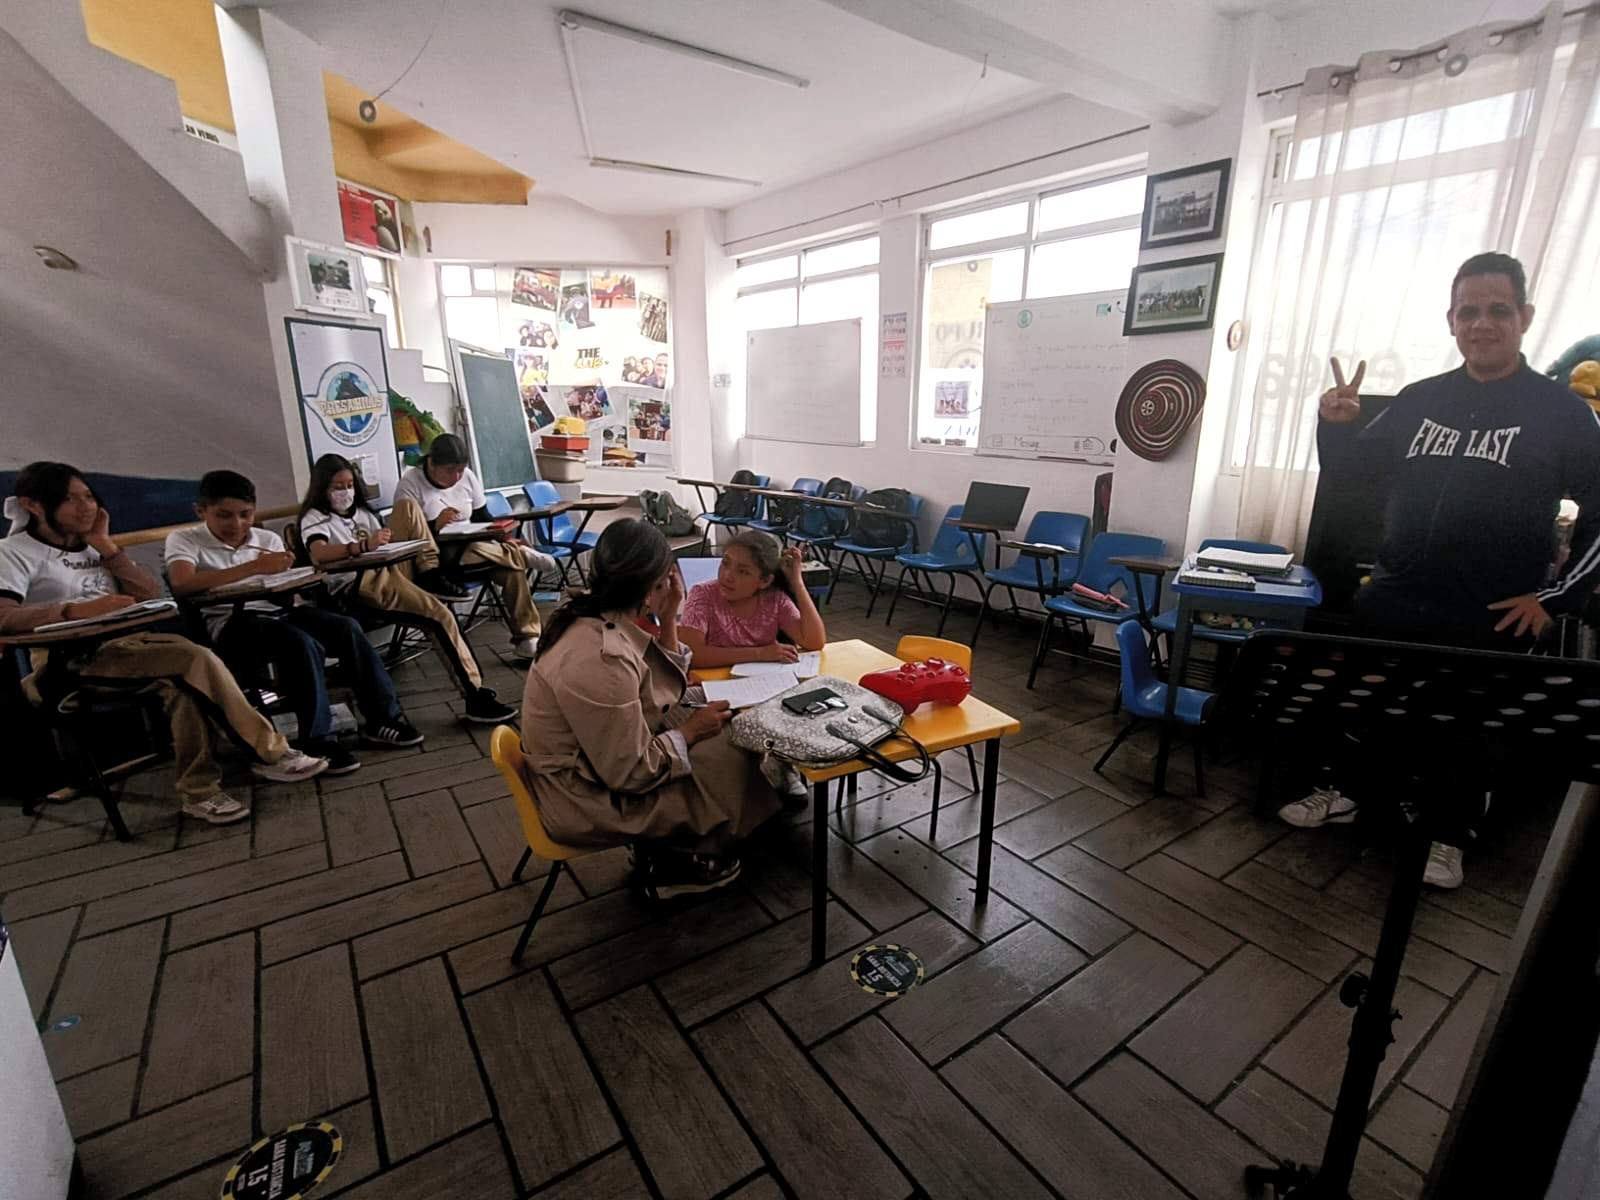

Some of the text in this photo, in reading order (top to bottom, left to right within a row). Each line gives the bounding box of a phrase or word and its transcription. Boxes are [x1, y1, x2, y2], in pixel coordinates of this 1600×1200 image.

[576, 347, 600, 358] THE
[1405, 417, 1521, 465] EVER LAST
[247, 1164, 269, 1187] 1.5
